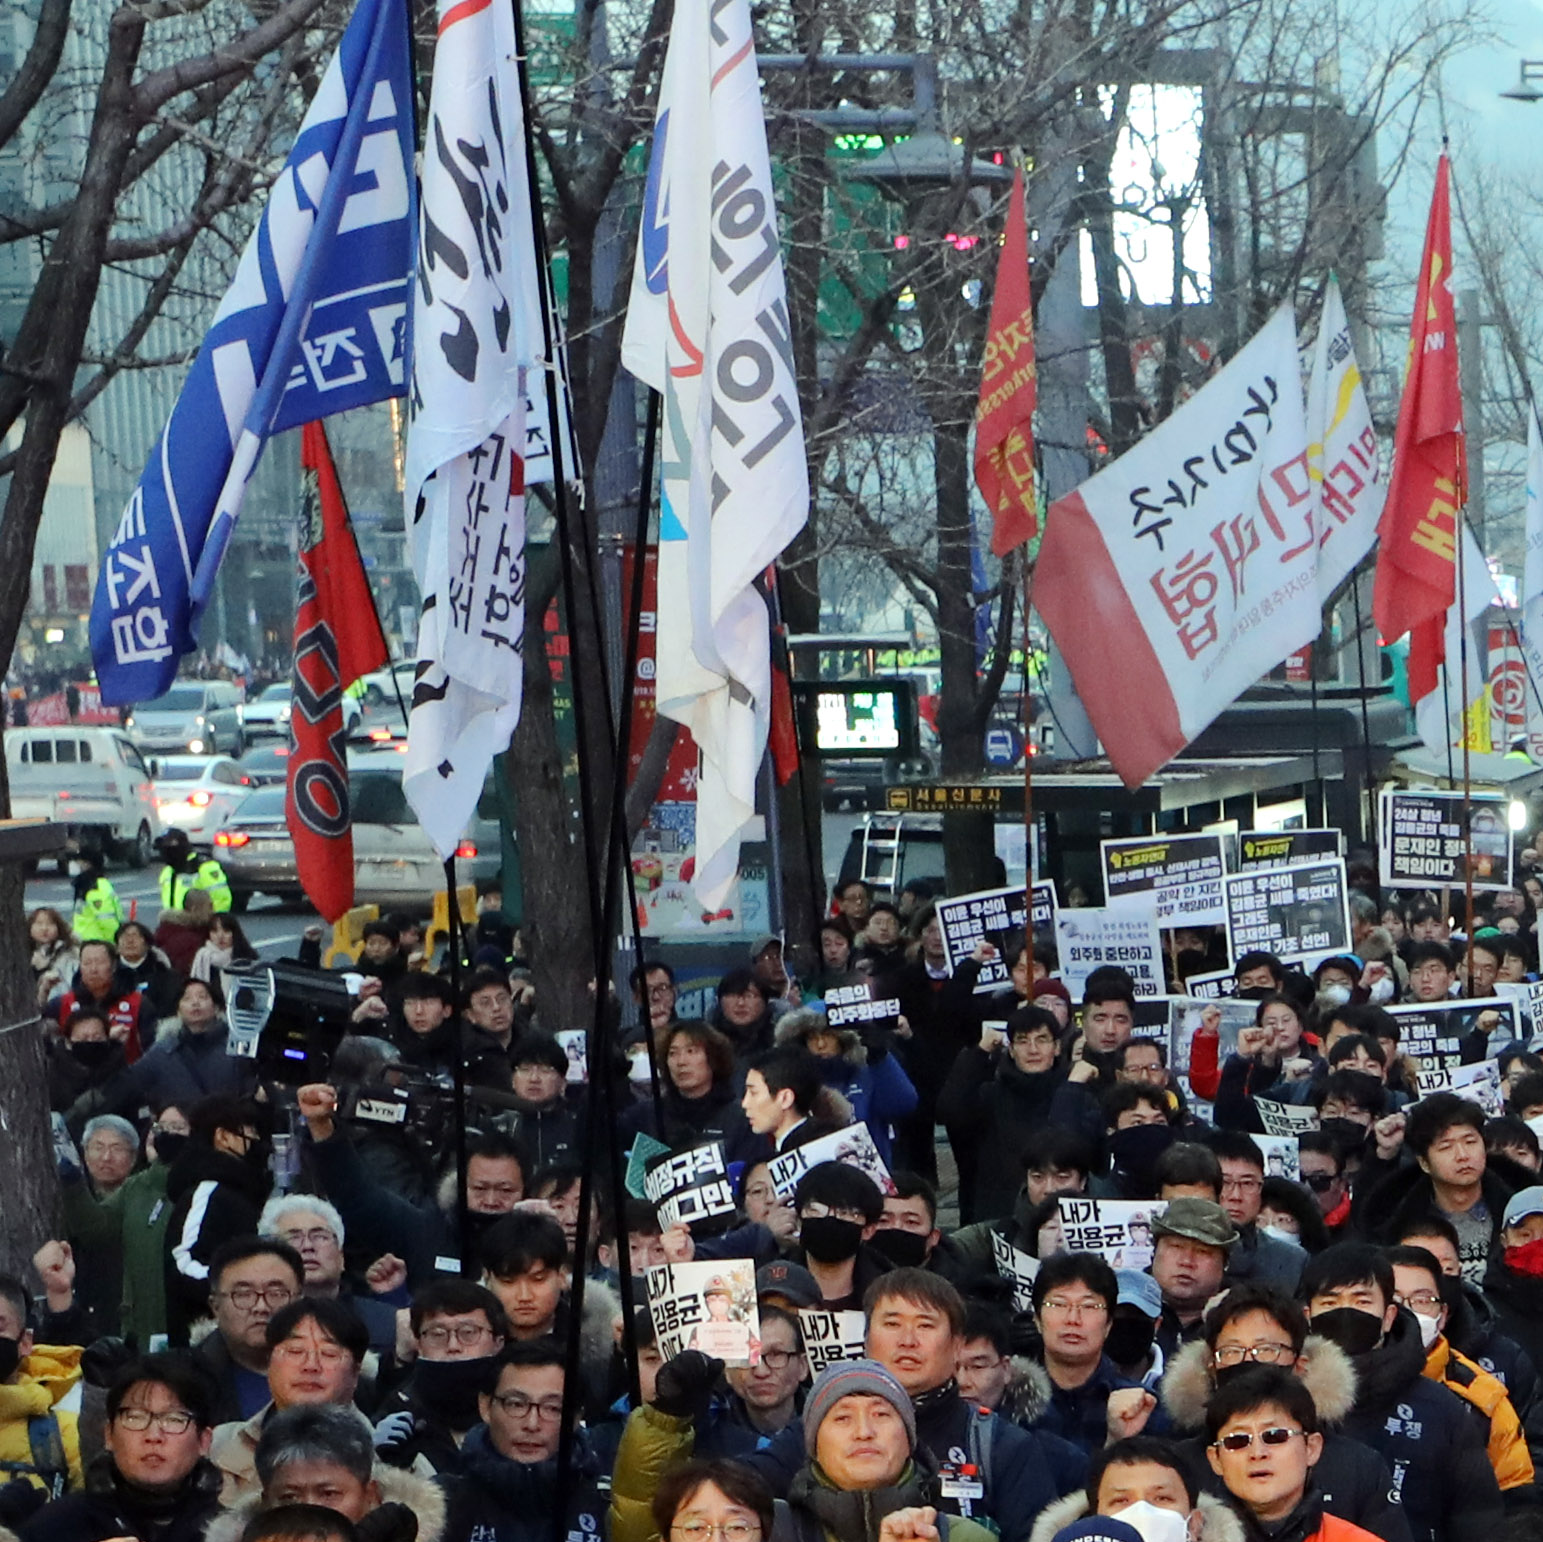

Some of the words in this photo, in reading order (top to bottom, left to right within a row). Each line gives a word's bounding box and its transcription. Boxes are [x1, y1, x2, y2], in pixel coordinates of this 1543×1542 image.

[1394, 837, 1443, 856] 문재인
[1394, 856, 1456, 877] 책임이다
[1105, 945, 1153, 962] 중단하고
[1059, 1200, 1102, 1225] 내가
[1064, 1225, 1127, 1251] 김용균
[646, 1264, 676, 1301] 내가
[651, 1293, 703, 1337] 김용균
[800, 1312, 840, 1342] 내가
[1383, 1416, 1422, 1440] 투쟁
